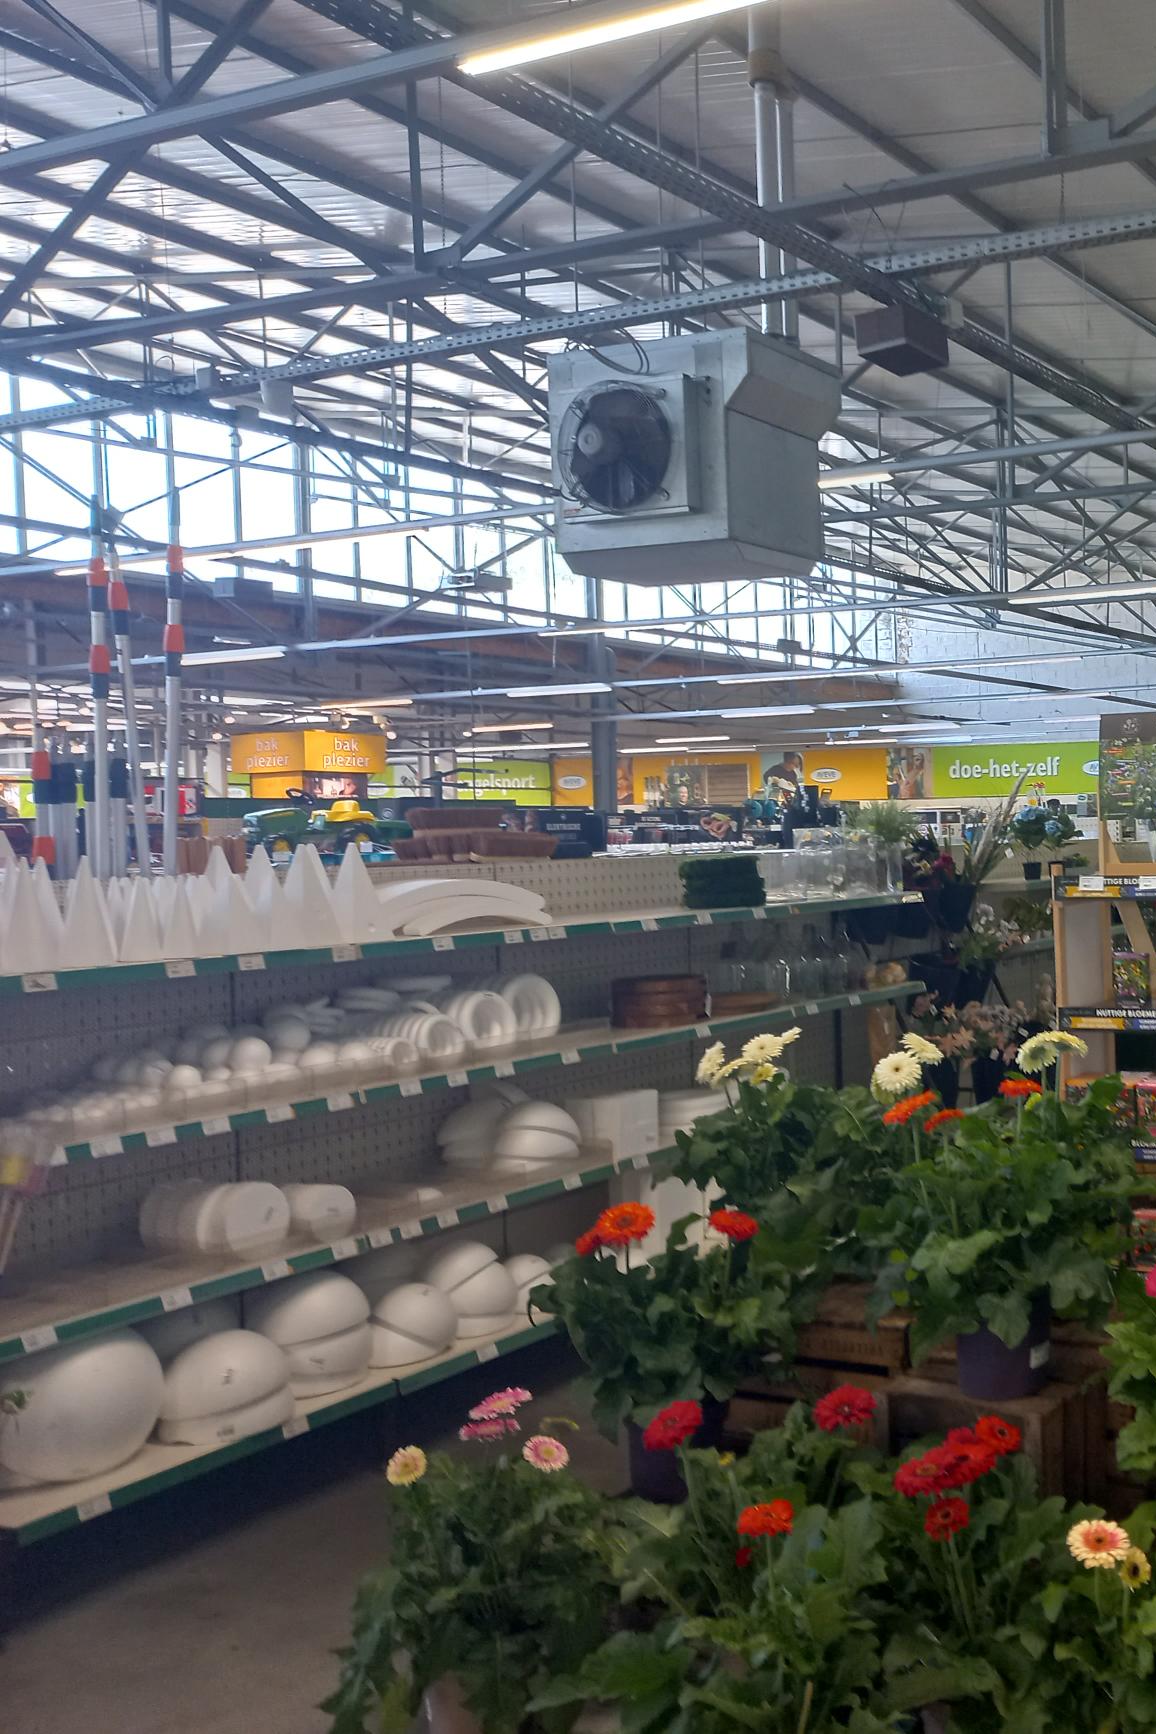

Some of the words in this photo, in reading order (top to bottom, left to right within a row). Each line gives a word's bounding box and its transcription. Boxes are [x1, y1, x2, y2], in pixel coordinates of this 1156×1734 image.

[255, 738, 278, 751] bak
[334, 737, 359, 751] bak
[246, 754, 289, 769] plezier
[323, 752, 370, 769] plezier
[949, 756, 1061, 779] doe-het-zelf
